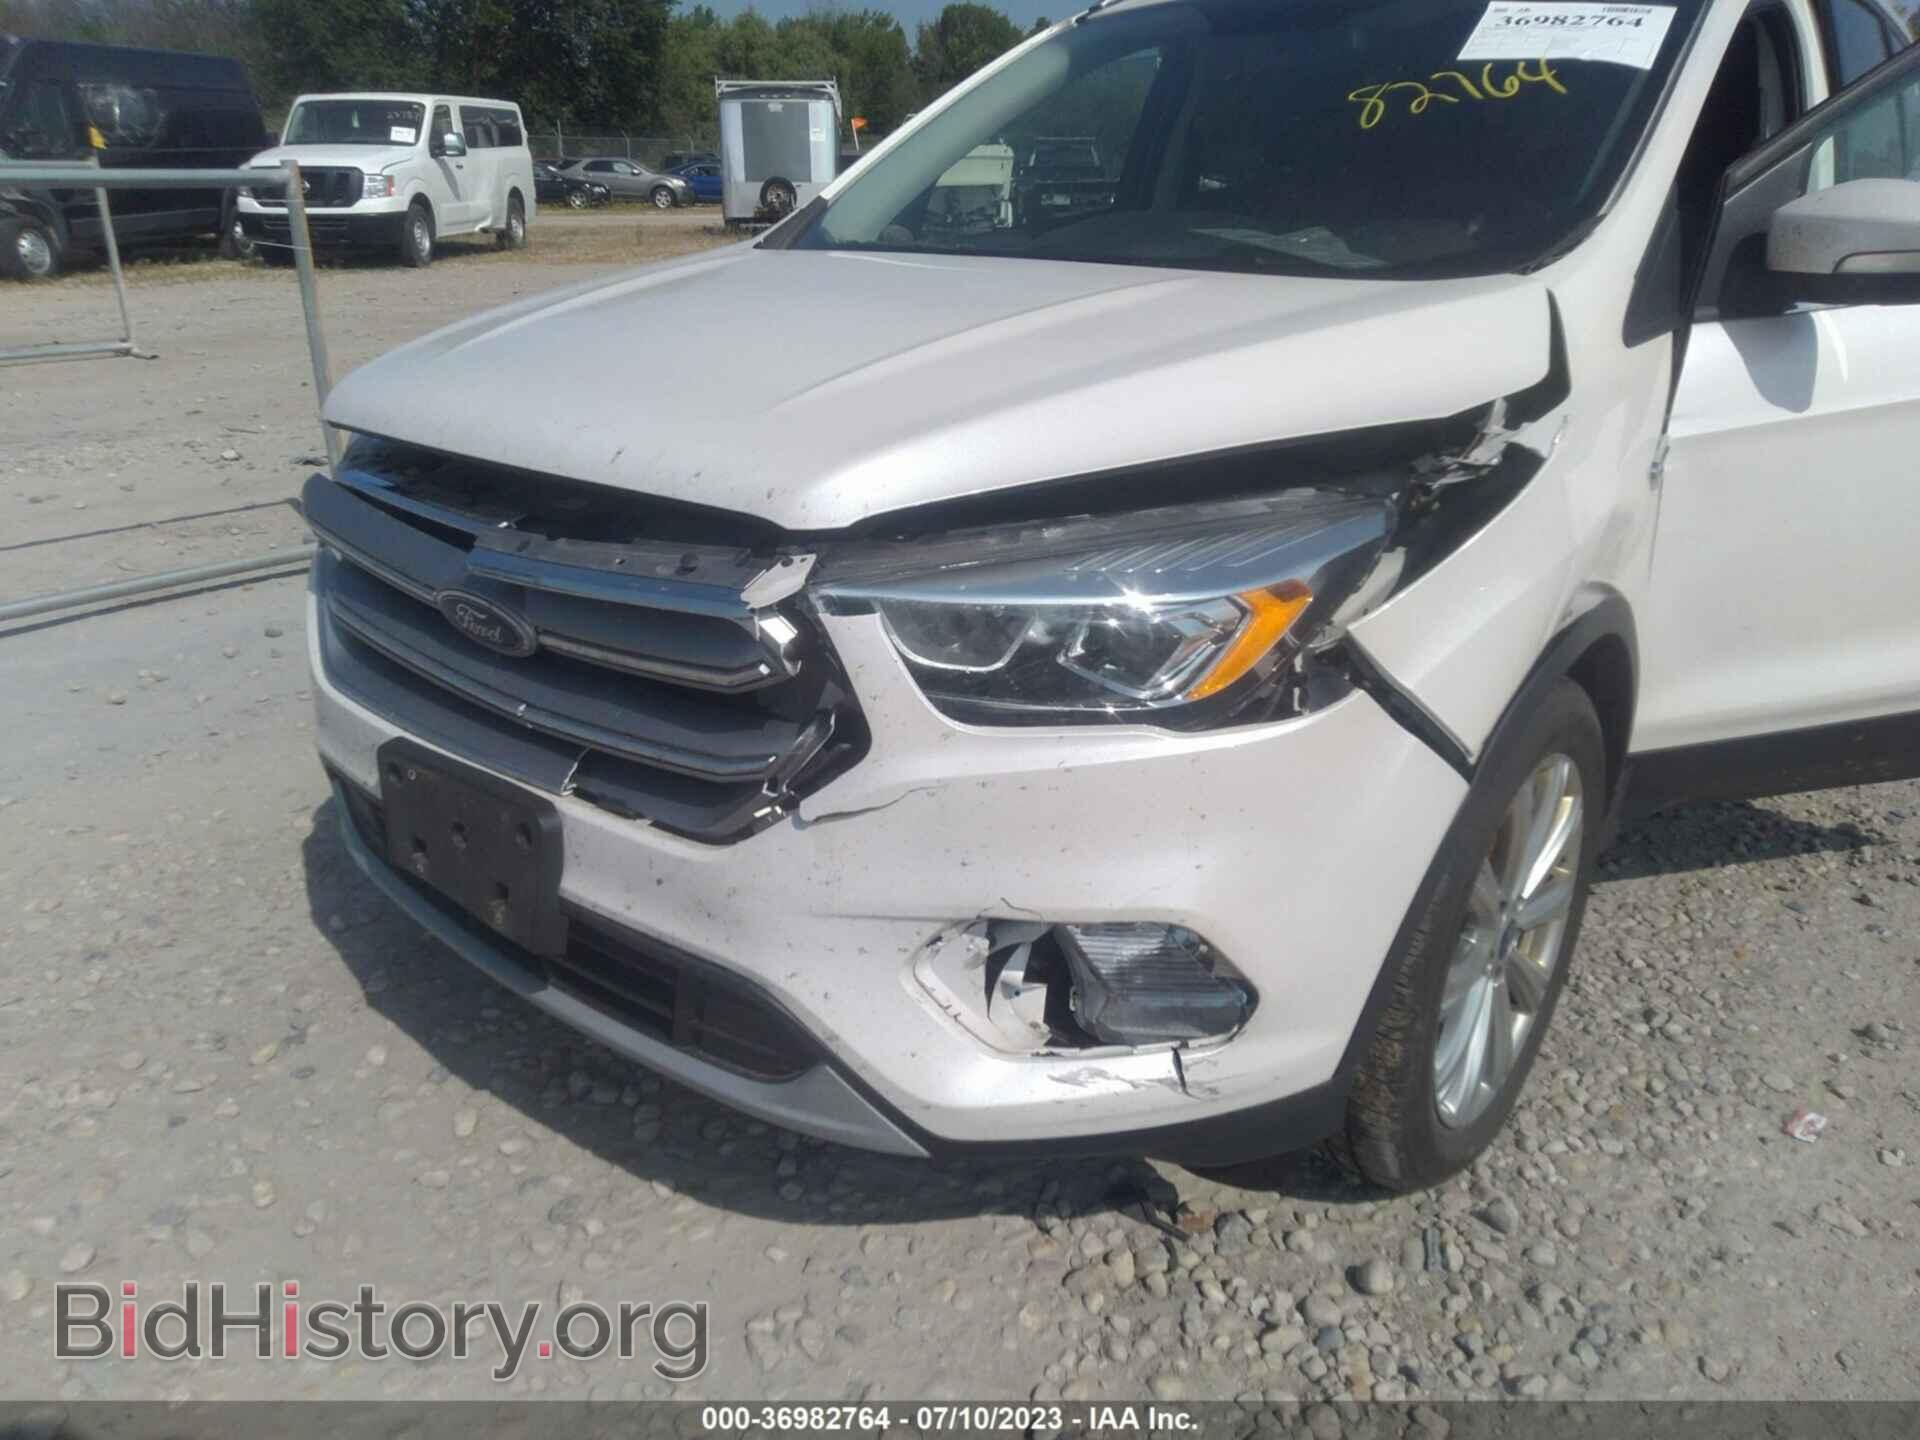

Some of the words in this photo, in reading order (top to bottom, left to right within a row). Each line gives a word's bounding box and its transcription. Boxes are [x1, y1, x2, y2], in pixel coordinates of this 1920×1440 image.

[1500, 14, 1644, 28] 36982764
[1348, 57, 1568, 128] 82764
[456, 603, 503, 642] Ford
